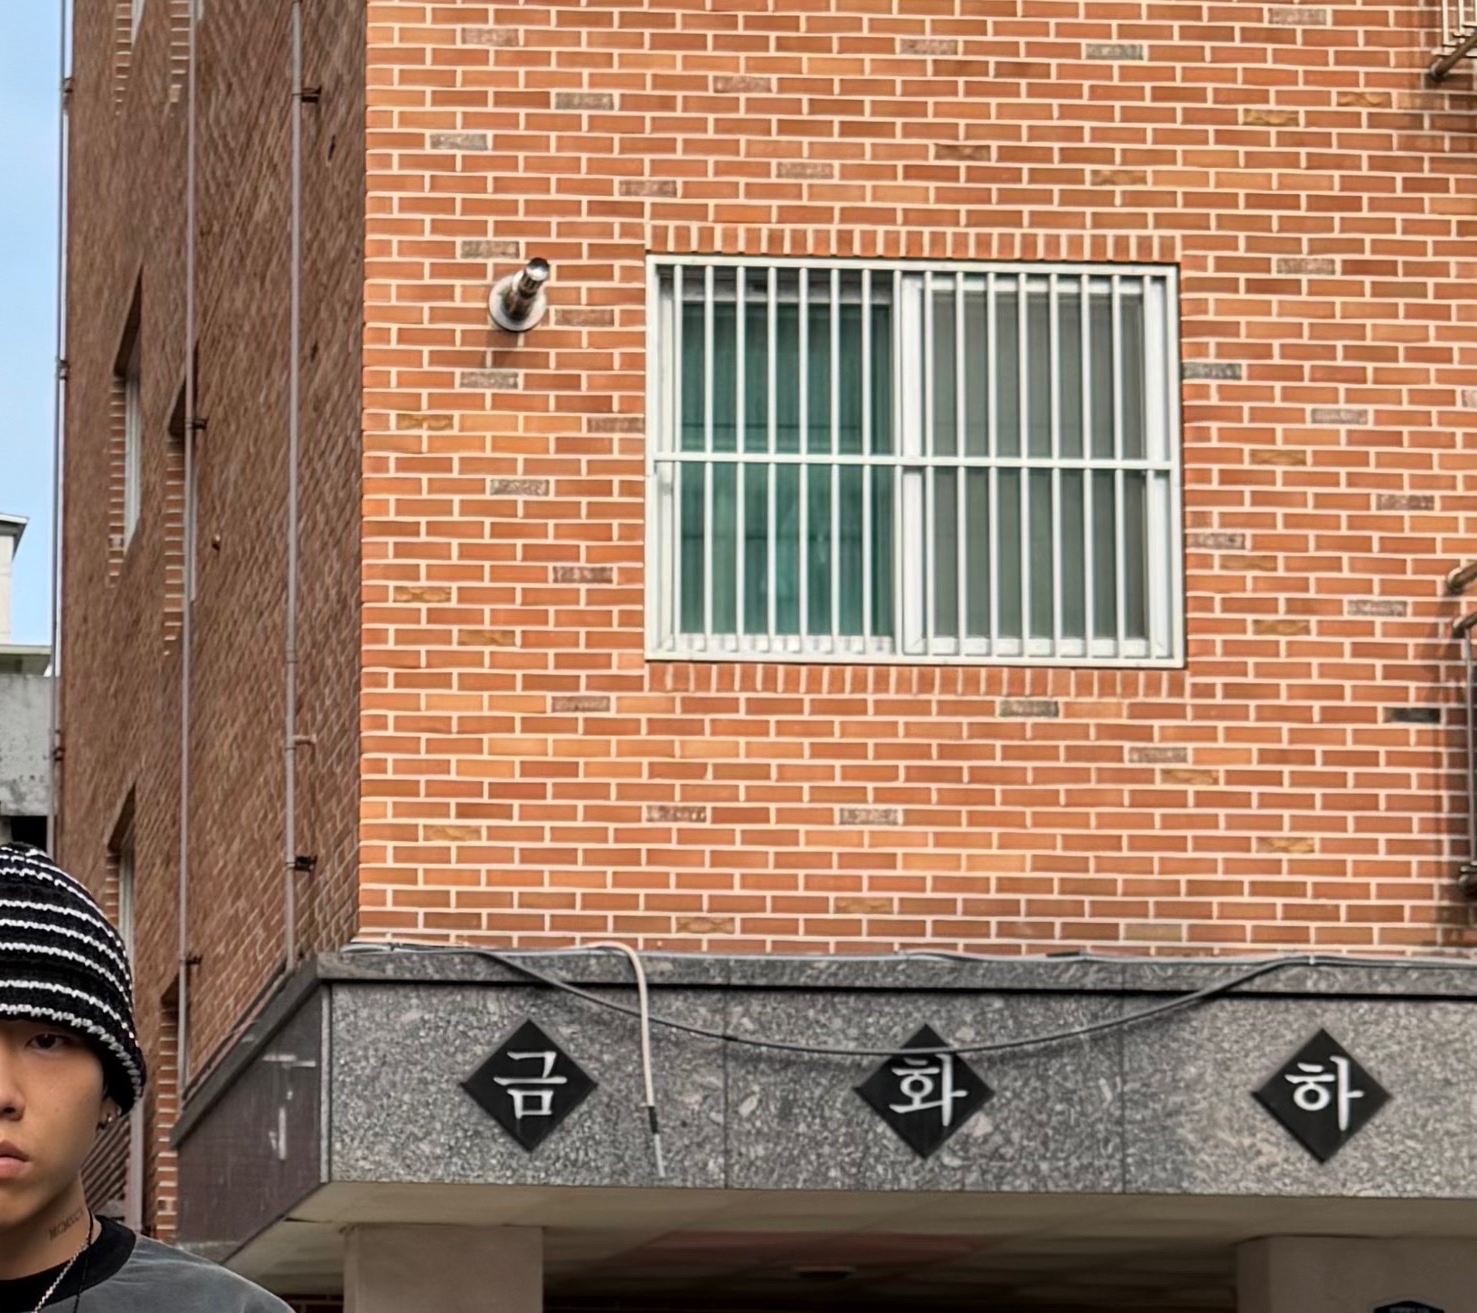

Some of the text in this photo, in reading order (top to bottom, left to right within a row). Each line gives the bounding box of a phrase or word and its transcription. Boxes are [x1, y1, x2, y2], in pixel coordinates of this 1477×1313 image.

[493, 1051, 1365, 1131] 금 화 하
